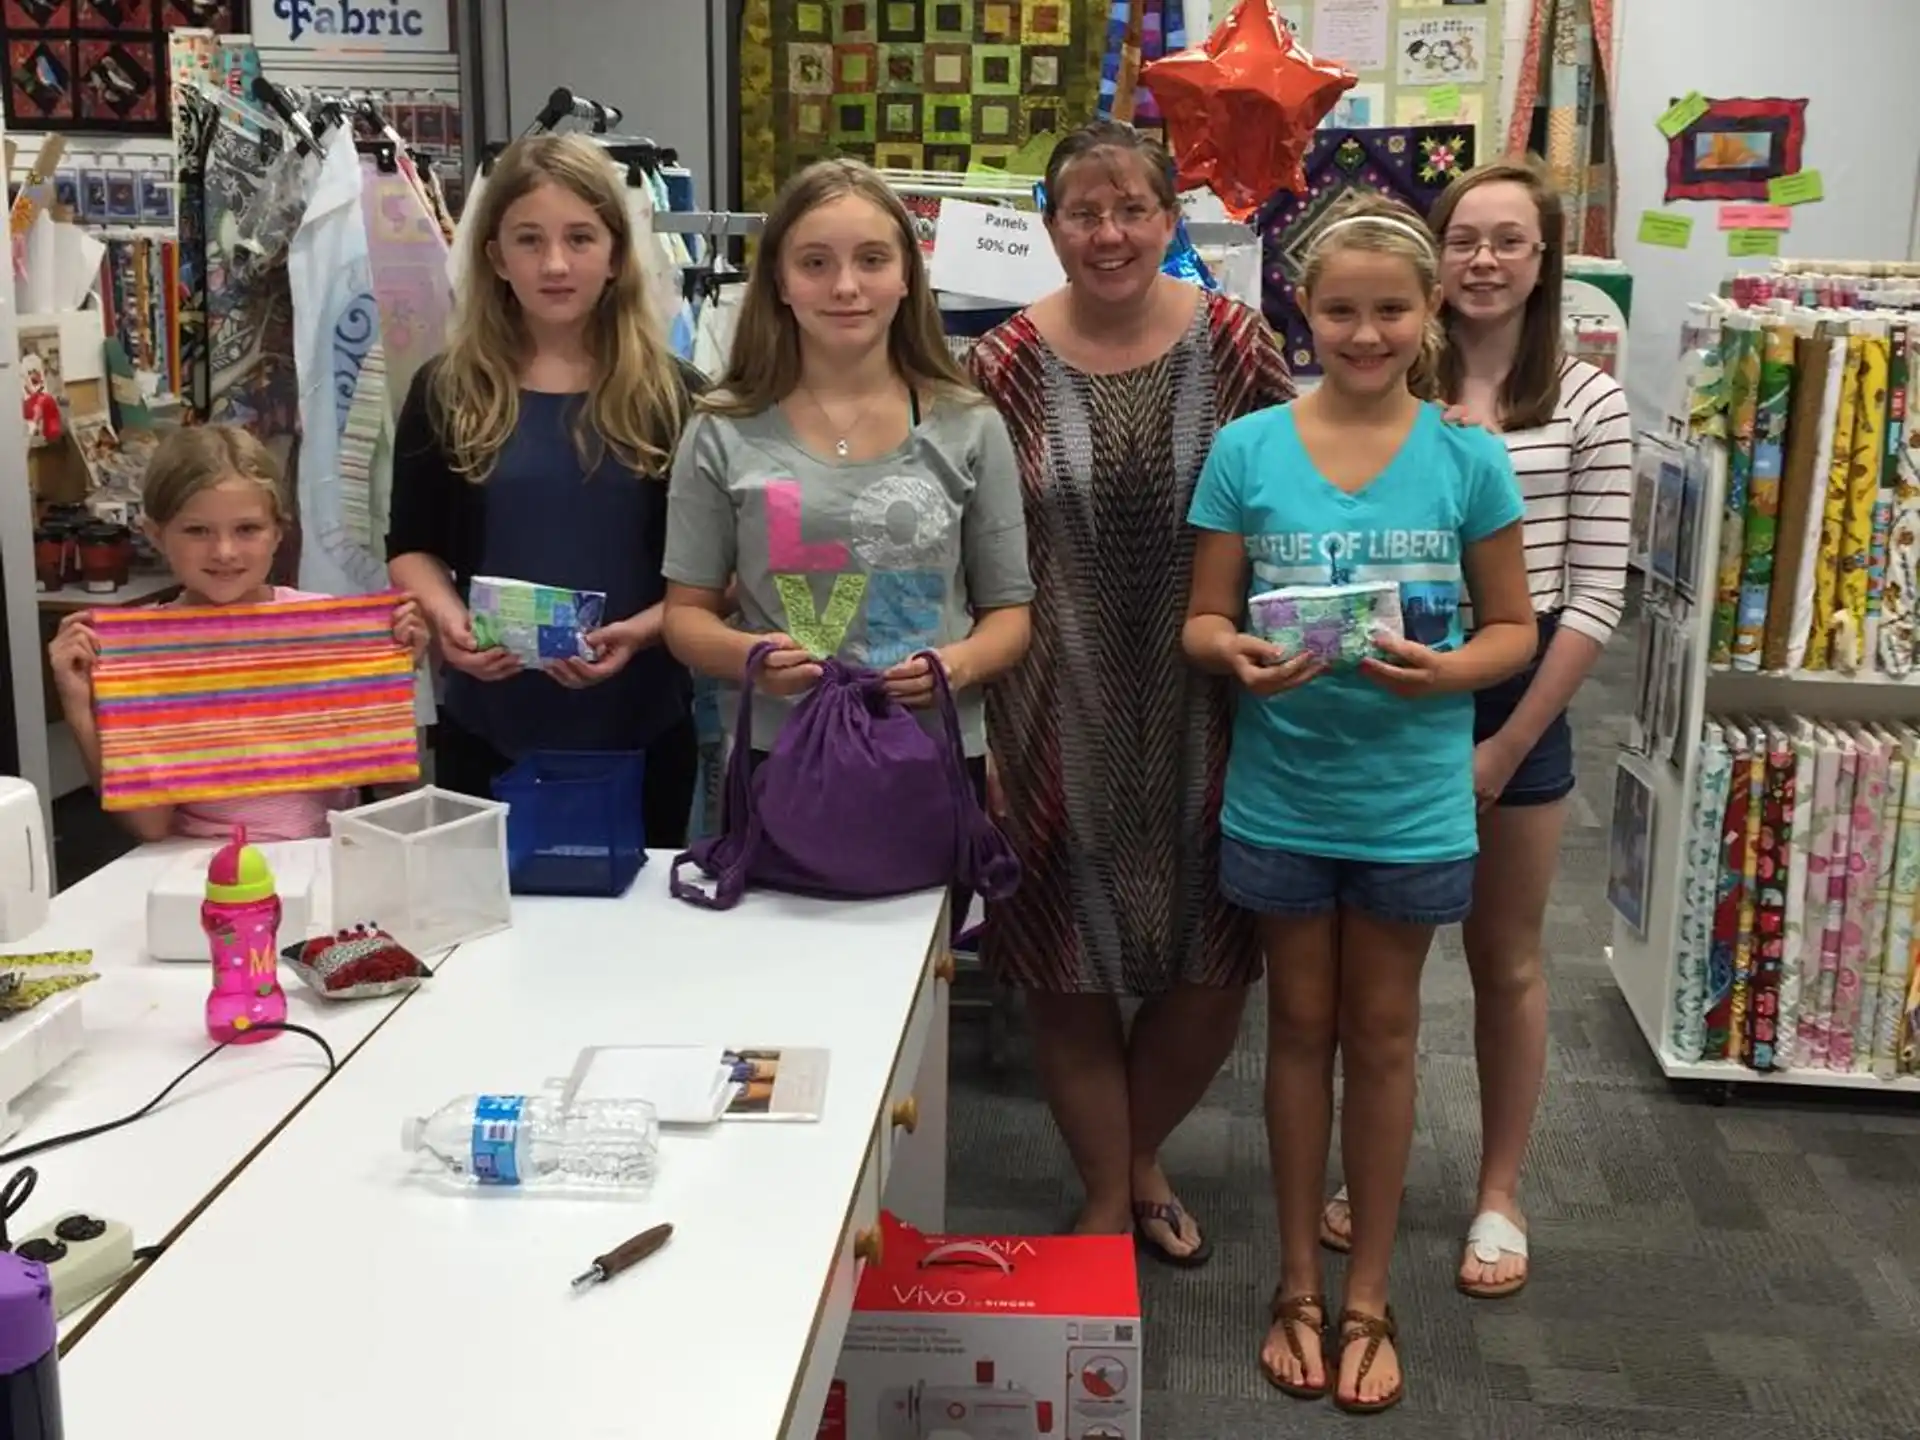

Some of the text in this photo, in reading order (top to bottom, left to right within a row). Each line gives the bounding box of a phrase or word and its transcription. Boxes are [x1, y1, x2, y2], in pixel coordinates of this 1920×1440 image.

[273, 0, 423, 41] Fabric
[985, 212, 1029, 231] Panels
[976, 236, 1029, 257] 50% Off
[1368, 528, 1458, 559] LIBERT
[892, 1284, 966, 1306] Vivo
